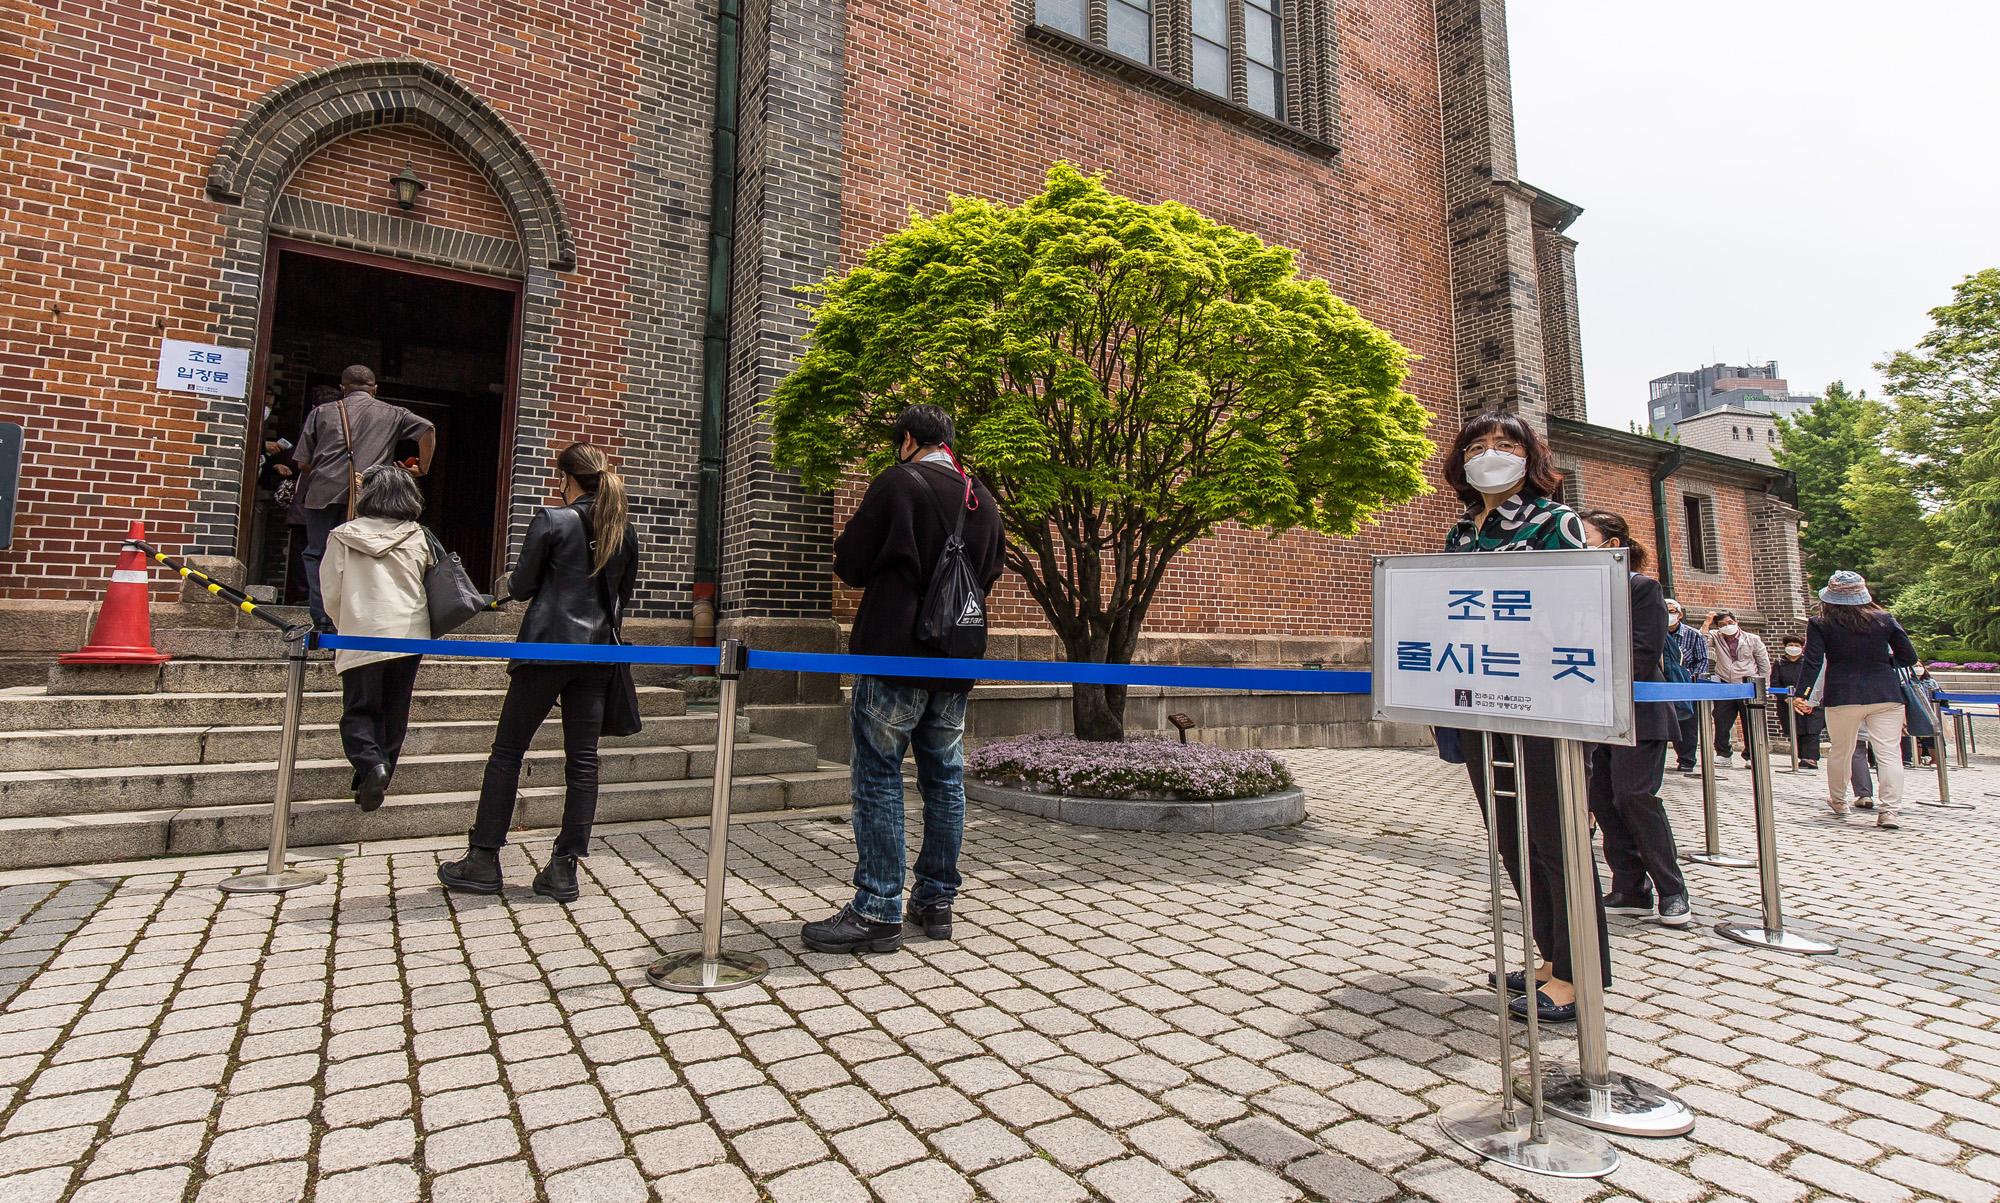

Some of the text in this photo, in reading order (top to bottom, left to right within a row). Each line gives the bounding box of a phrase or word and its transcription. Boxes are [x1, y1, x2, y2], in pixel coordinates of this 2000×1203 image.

[188, 350, 222, 365] 조문
[177, 366, 229, 384] 입장문
[1447, 590, 1532, 621] 조문
[1397, 641, 1596, 684] 줄서는 곳
